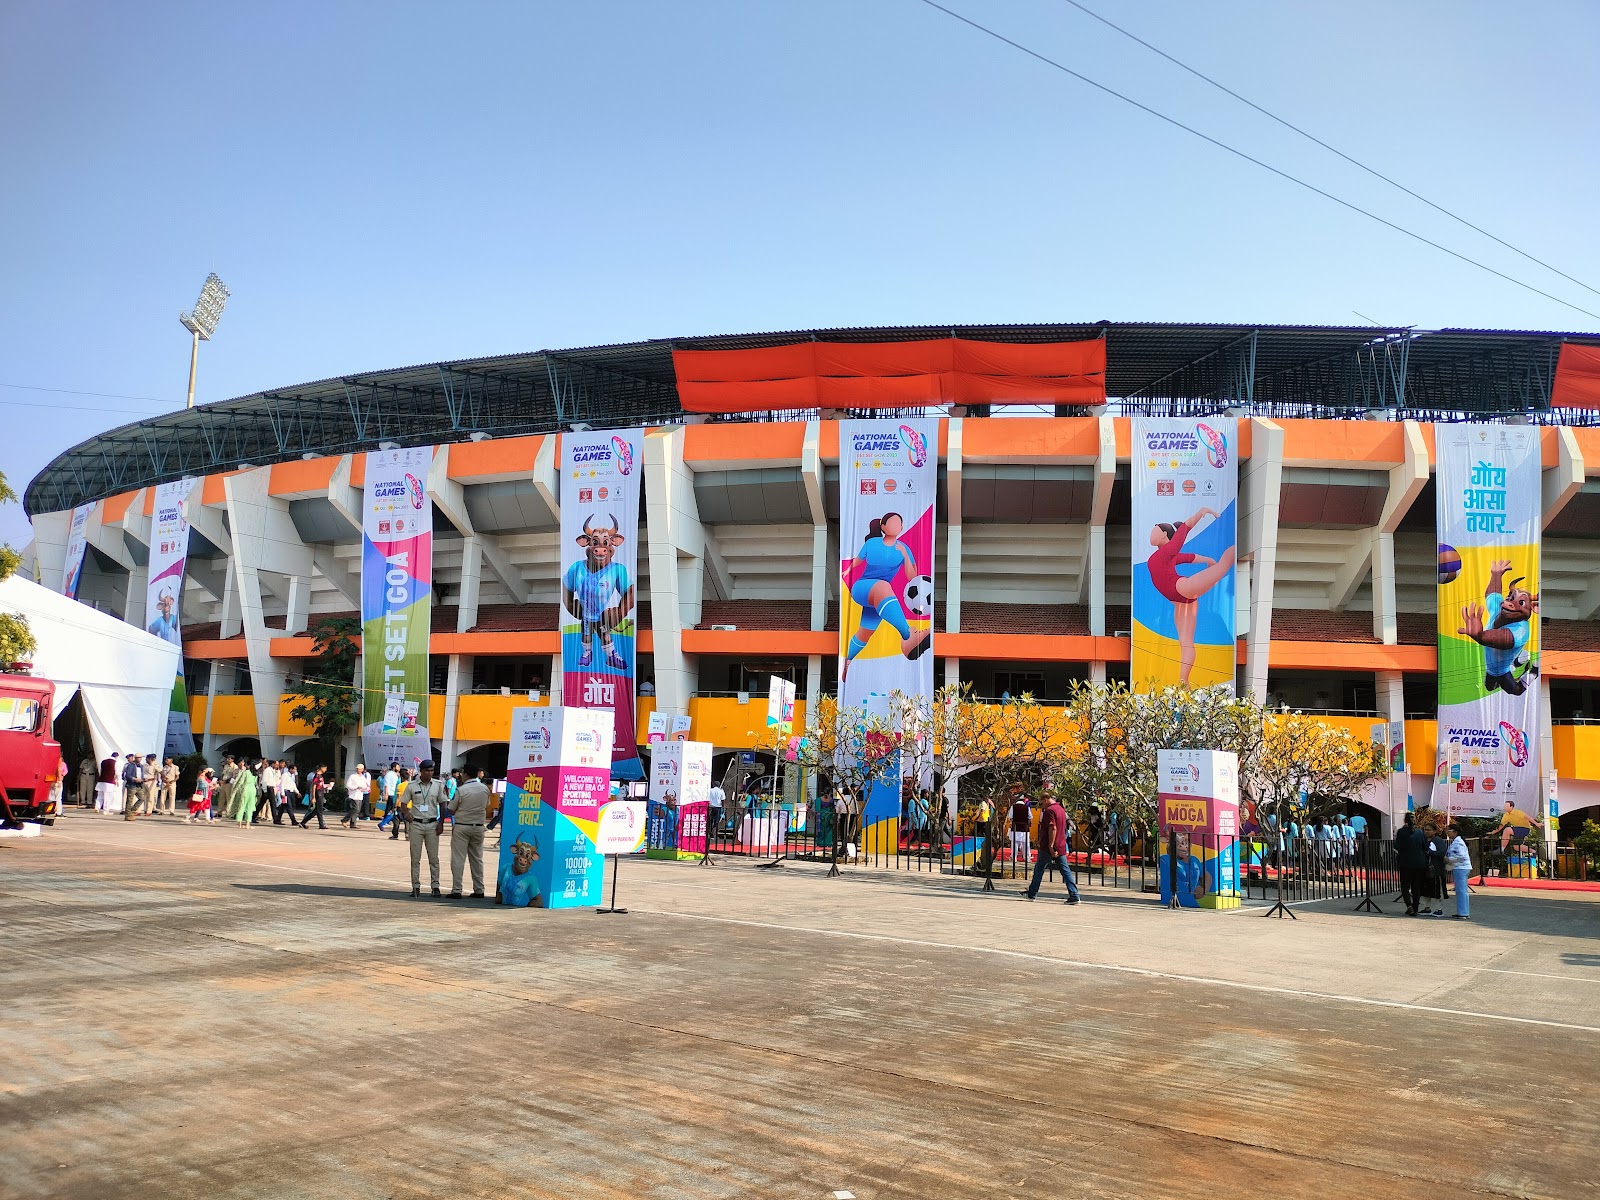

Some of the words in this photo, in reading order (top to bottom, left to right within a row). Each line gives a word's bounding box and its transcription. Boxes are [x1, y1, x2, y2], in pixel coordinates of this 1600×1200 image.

[853, 433, 897, 441] NATIONAL
[572, 444, 610, 453] NATIONAL
[854, 441, 900, 451] GAMES
[1148, 440, 1199, 450] GAMES
[574, 451, 612, 462] GAMES
[375, 487, 405, 497] GAMES
[1464, 489, 1506, 510] आसा
[158, 507, 177, 515] NATIONAL
[159, 513, 178, 522] GAMES
[386, 552, 409, 604] GOA
[385, 610, 408, 661] SET
[384, 665, 405, 699] ET
[1448, 728, 1498, 737] NATIONAL
[564, 775, 593, 783] WELCOME
[595, 776, 603, 784] TO
[569, 783, 584, 791] NEW
[597, 784, 606, 792] OF
[562, 791, 592, 799] SPORTING
[518, 793, 541, 809] आसा
[562, 799, 597, 807] EXCELLENCE
[1168, 807, 1204, 822] MOGA
[575, 834, 585, 845] 43
[565, 857, 592, 869] 10000+
[565, 880, 576, 892] 28
[583, 879, 589, 891] 8
